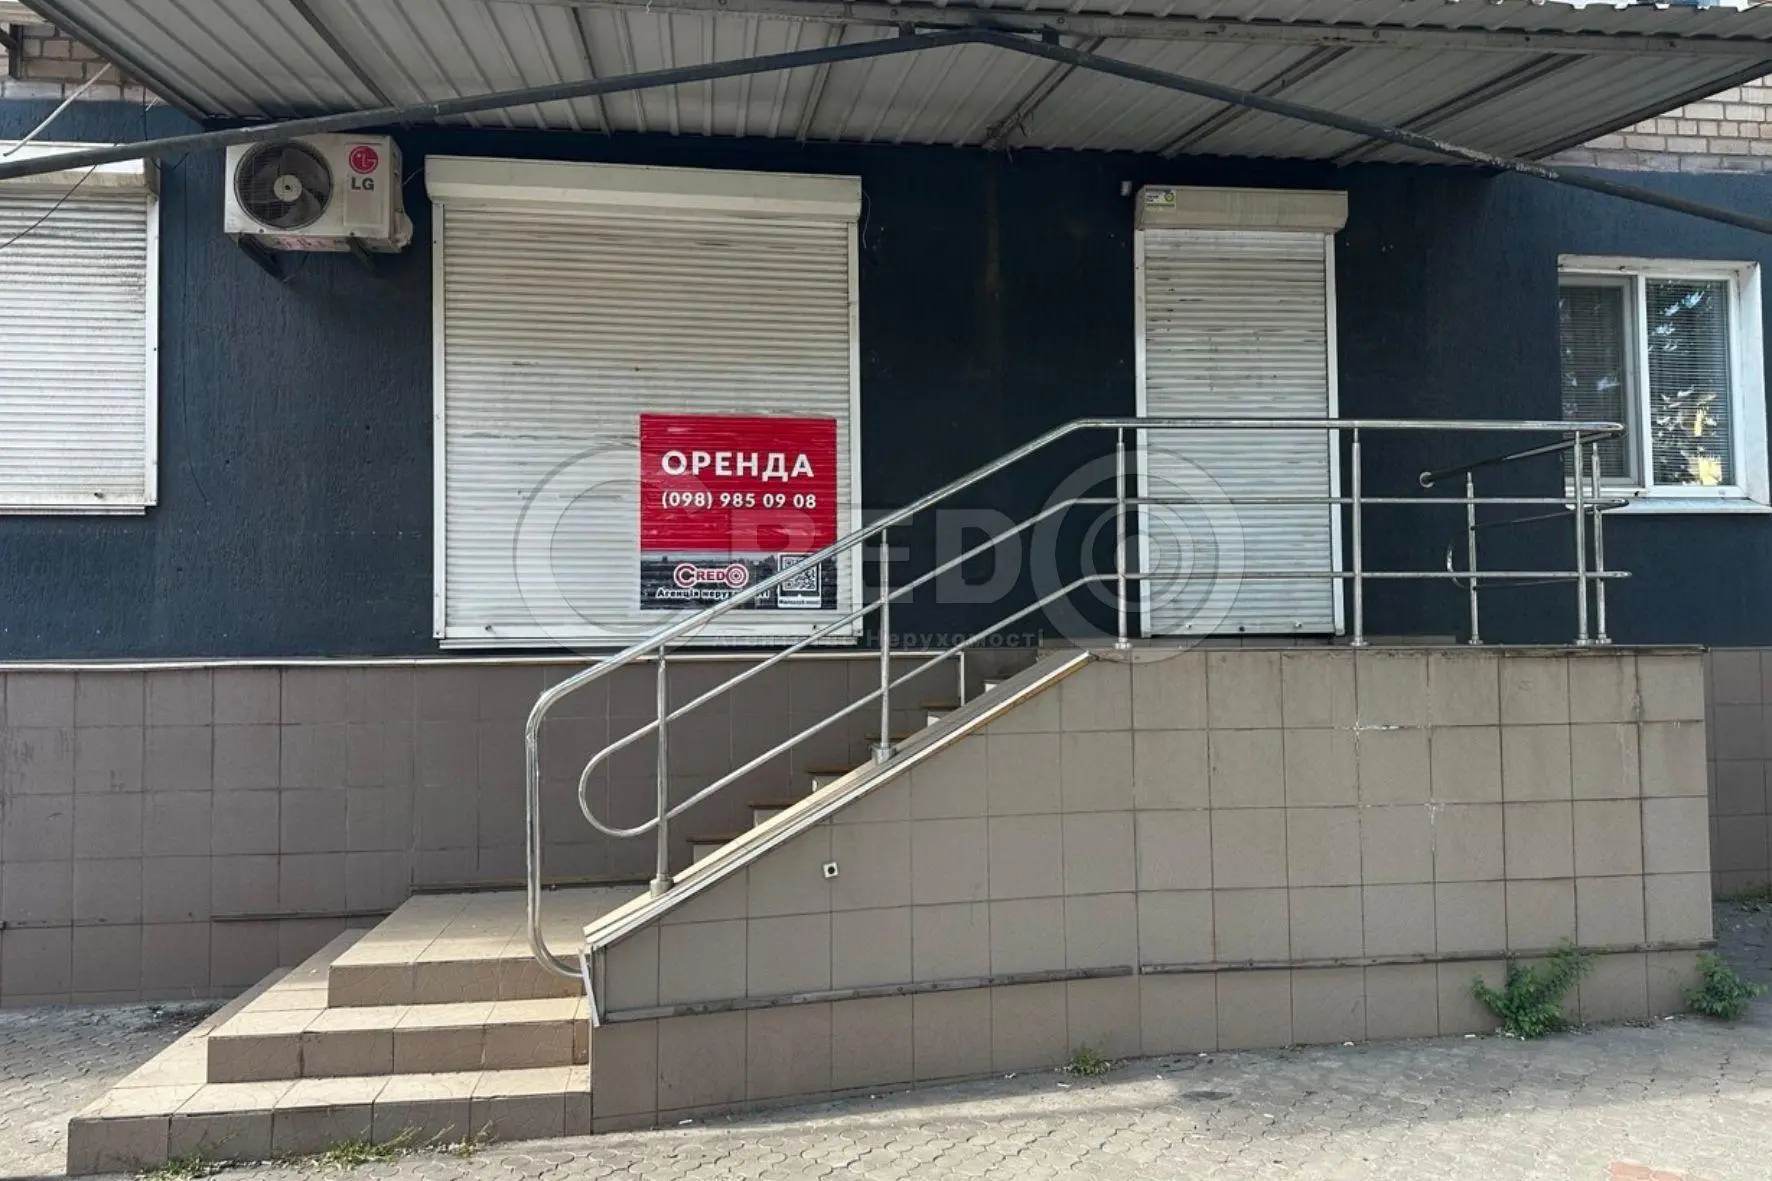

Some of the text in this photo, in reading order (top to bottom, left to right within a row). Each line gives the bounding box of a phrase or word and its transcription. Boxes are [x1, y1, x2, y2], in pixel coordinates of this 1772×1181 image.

[351, 177, 374, 191] LG
[661, 450, 814, 482] ОРЕНДА
[661, 491, 817, 509] (098) 985 09 08
[674, 563, 749, 588] CREDO
